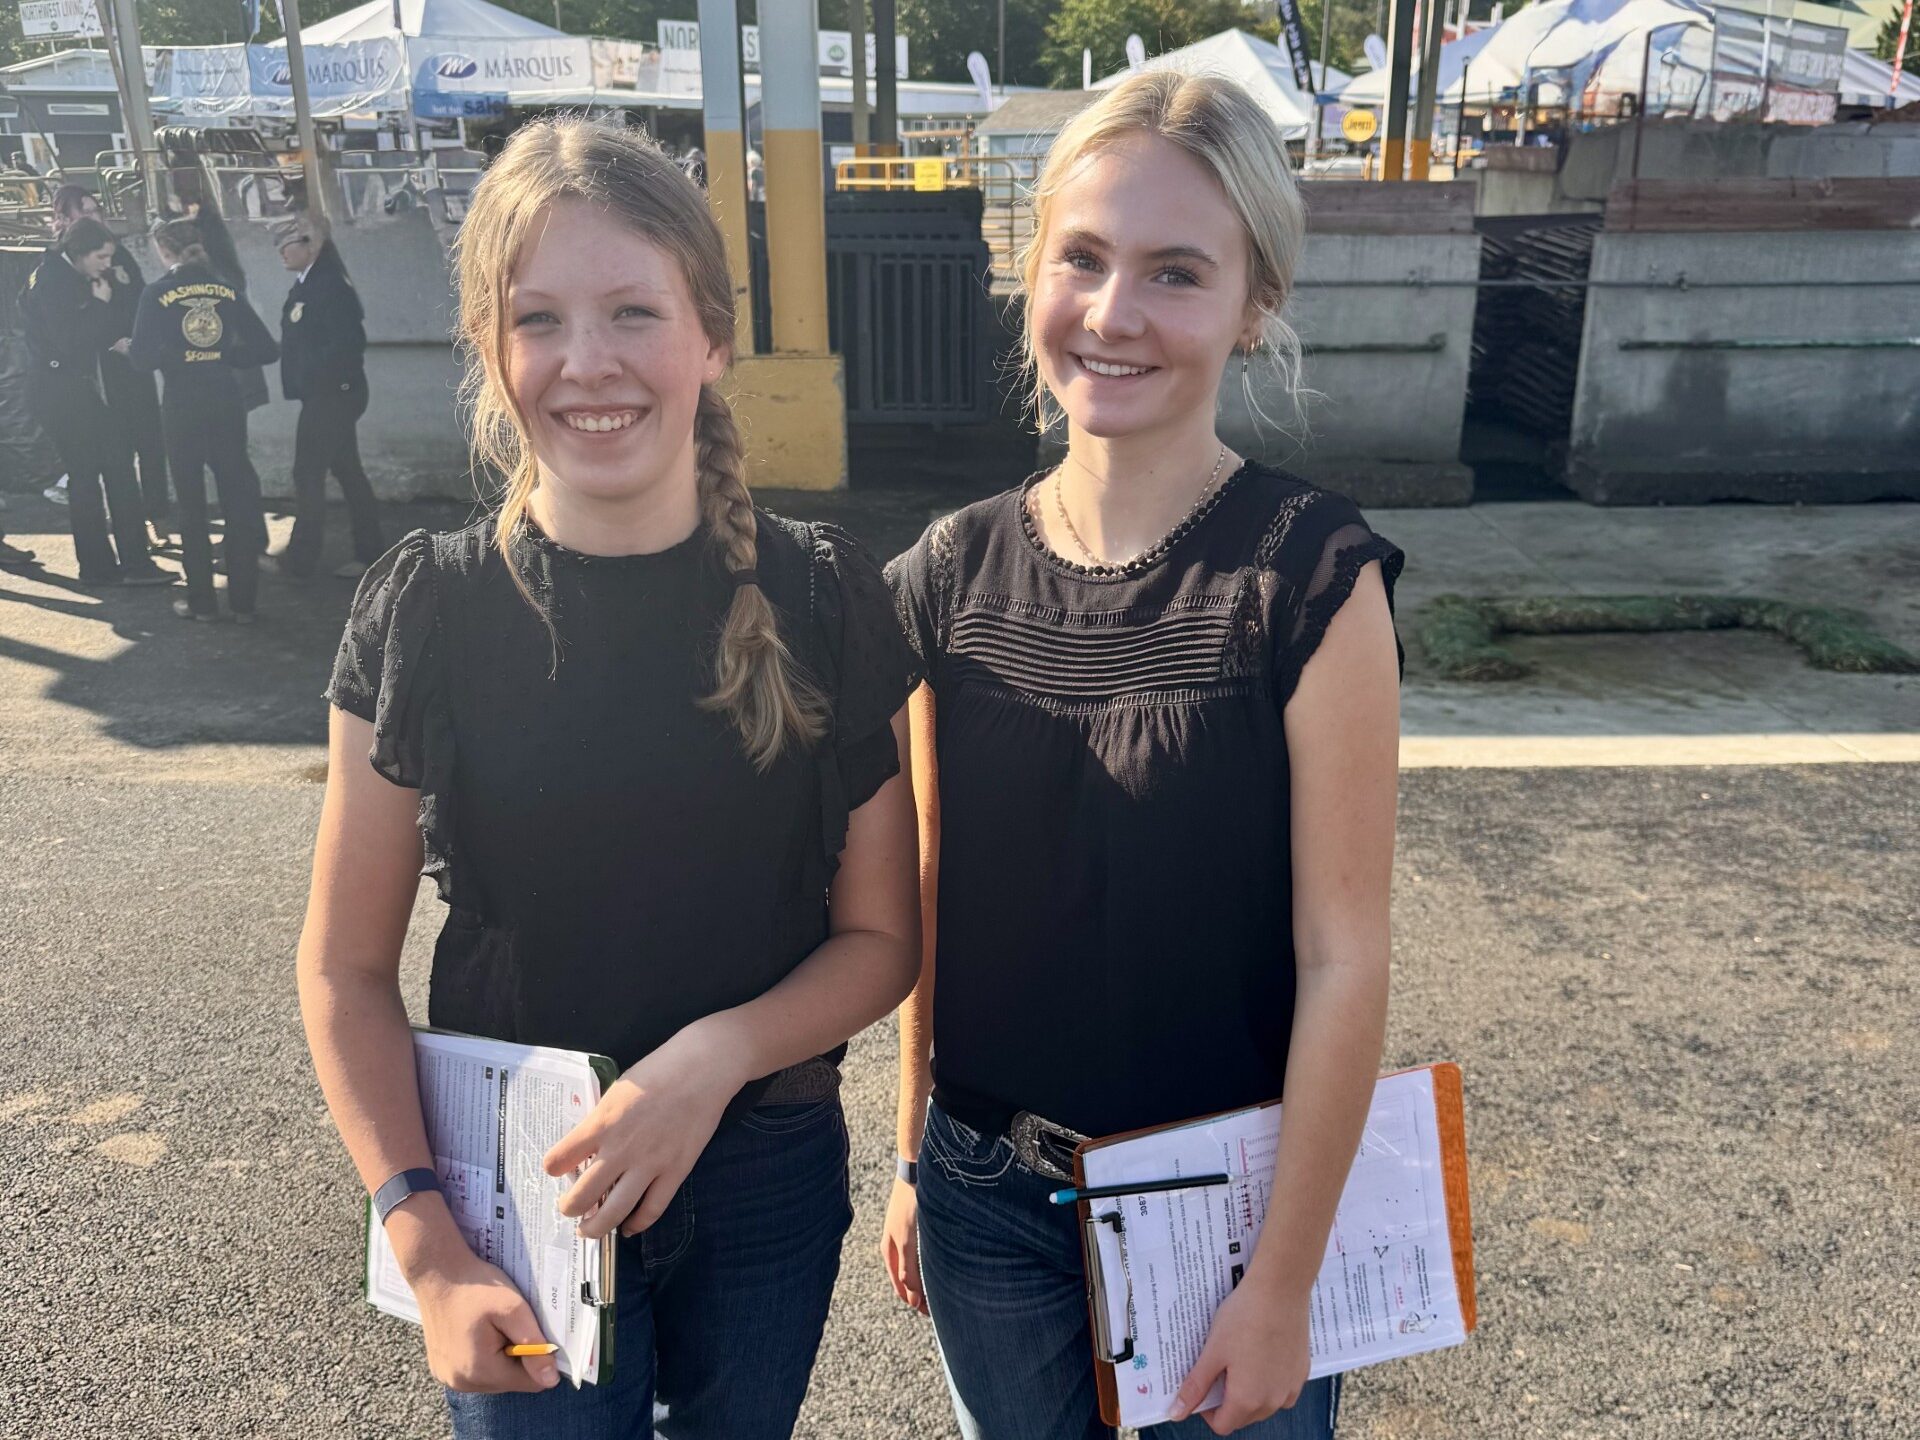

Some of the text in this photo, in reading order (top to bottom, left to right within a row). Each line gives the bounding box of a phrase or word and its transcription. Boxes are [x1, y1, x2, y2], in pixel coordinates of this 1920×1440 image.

[22, 2, 62, 20] NORTHWEST
[307, 57, 386, 84] MARQUIS
[484, 54, 573, 82] MARQUIS
[159, 284, 236, 307] WASHINGTON
[1138, 1195, 1148, 1216] 3087
[569, 1265, 577, 1298] Judging
[1127, 1297, 1139, 1341] Washington
